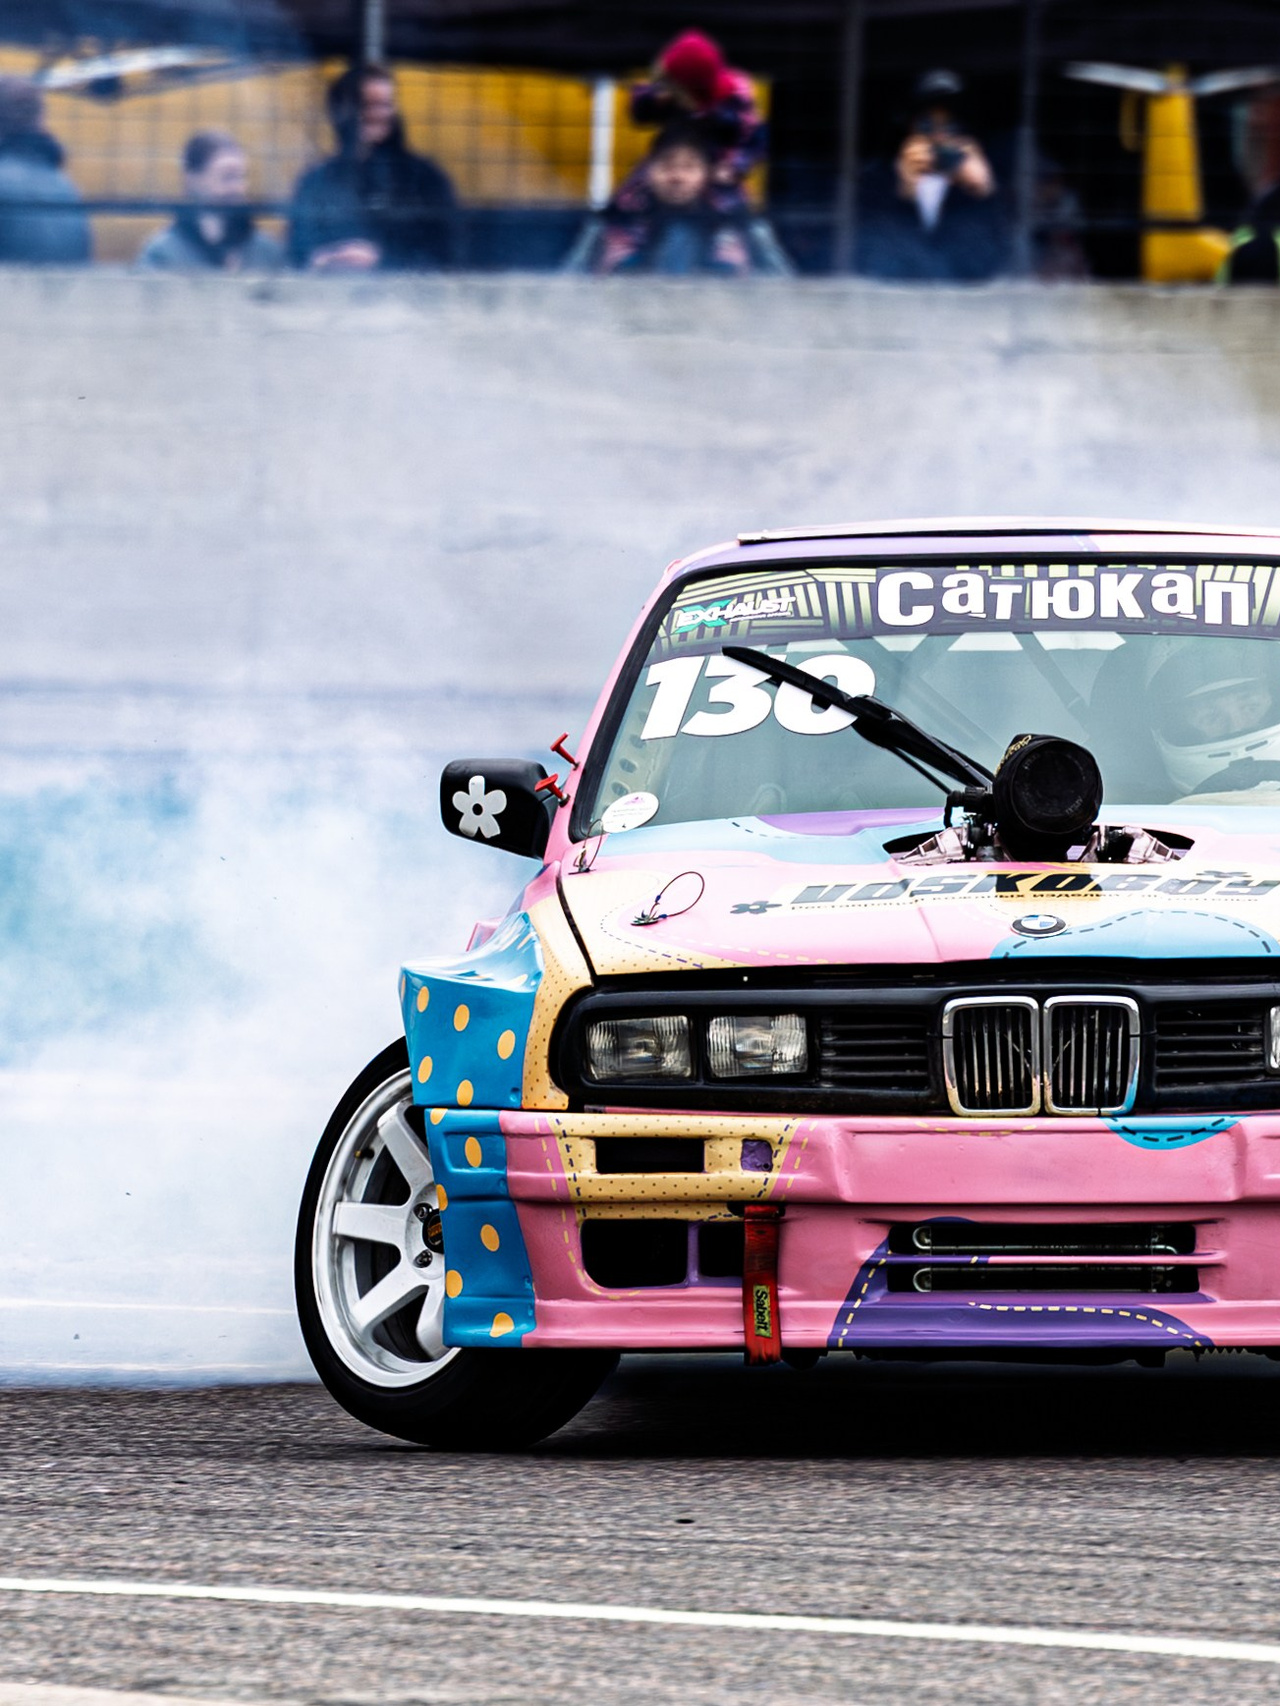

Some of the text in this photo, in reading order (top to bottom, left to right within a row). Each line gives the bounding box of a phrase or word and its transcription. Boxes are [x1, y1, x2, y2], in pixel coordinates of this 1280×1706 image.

[676, 596, 797, 628] EXHAUST
[877, 571, 1250, 627] Сатюкап
[640, 654, 876, 740] 130
[754, 1289, 769, 1331] Sabelt
